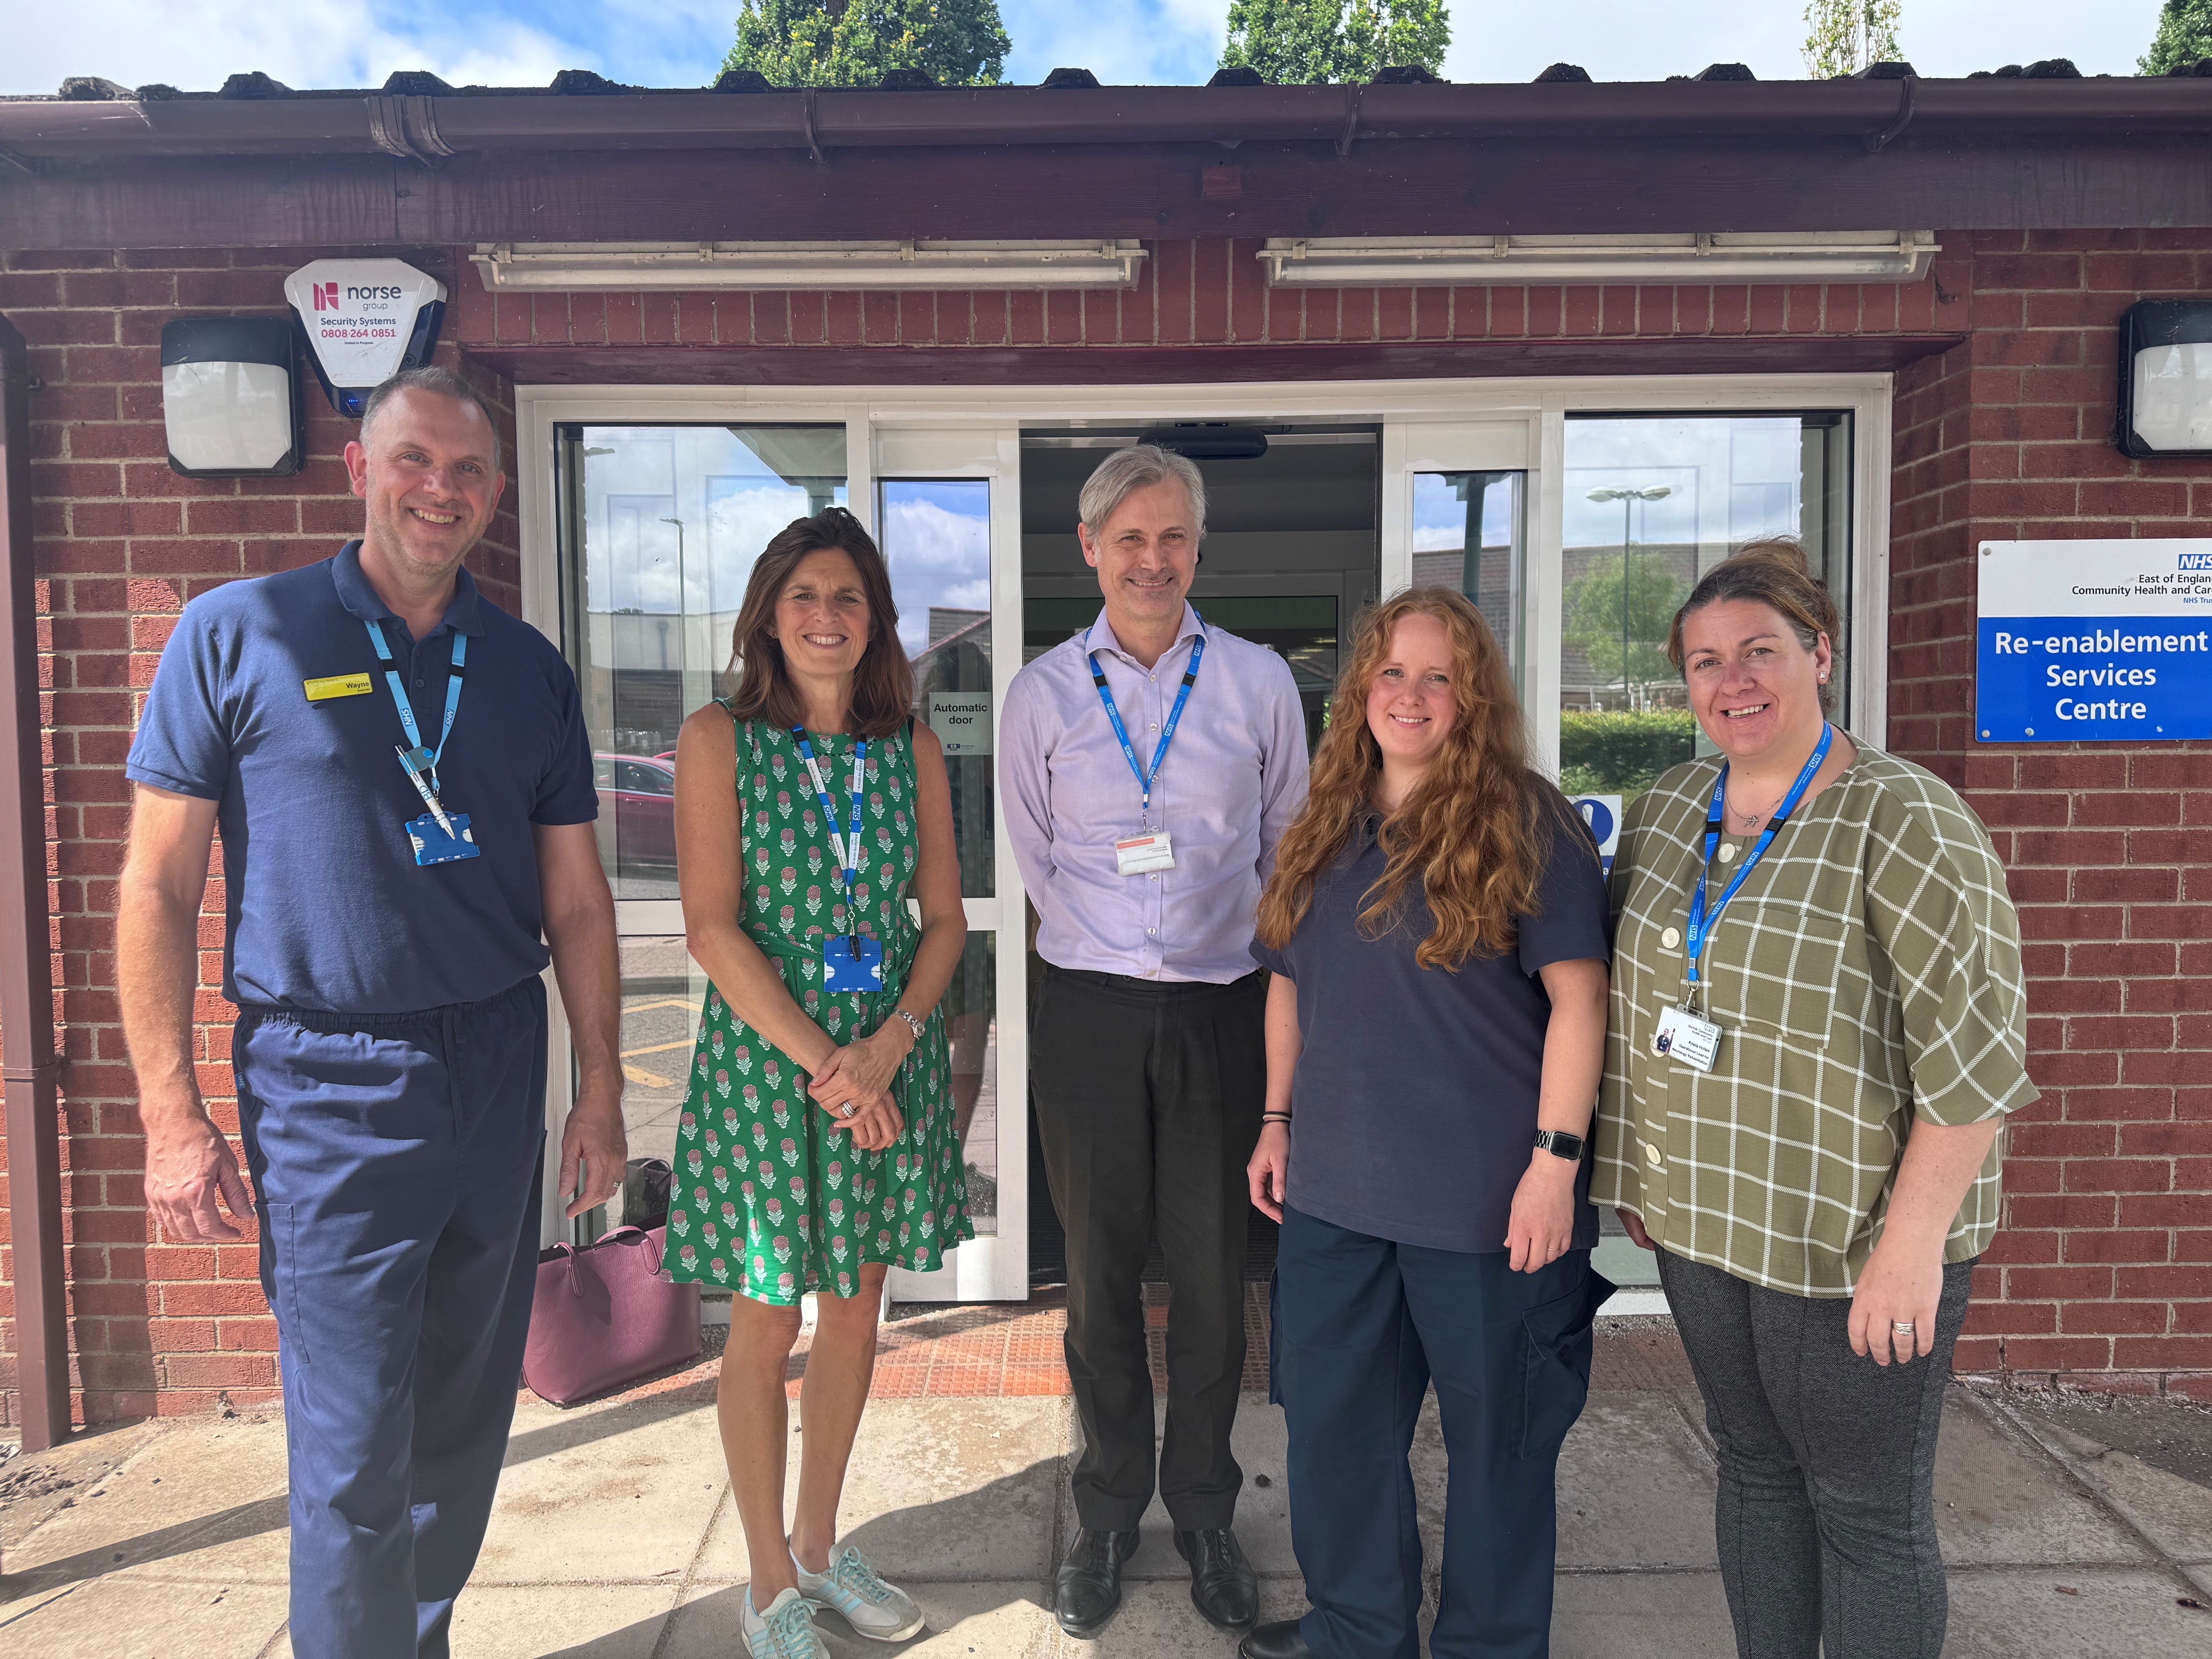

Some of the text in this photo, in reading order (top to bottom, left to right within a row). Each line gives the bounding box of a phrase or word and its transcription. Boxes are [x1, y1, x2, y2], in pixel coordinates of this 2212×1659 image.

[348, 287, 401, 299] norse
[321, 318, 396, 326] Security Systems
[321, 329, 396, 338] 0808 264 0851
[2179, 555, 2212, 568] NHS
[2139, 574, 2212, 585] East of Englan
[2072, 585, 2212, 596] Community Health and Car
[1996, 629, 2208, 654] Re-enablement
[2046, 663, 2156, 687] Services
[934, 703, 987, 712] Automatic
[2055, 698, 2147, 720] Centre
[401, 709, 412, 725] NHS
[445, 709, 454, 725] NHS
[949, 716, 973, 724] door
[1809, 754, 1821, 768] NHS
[419, 785, 433, 800] BD
[824, 806, 832, 821] NHS
[1746, 852, 1759, 865] NHS
[1679, 1044, 1696, 1053] Operational
[1672, 1048, 1707, 1065] Neurology Rehabilitation
